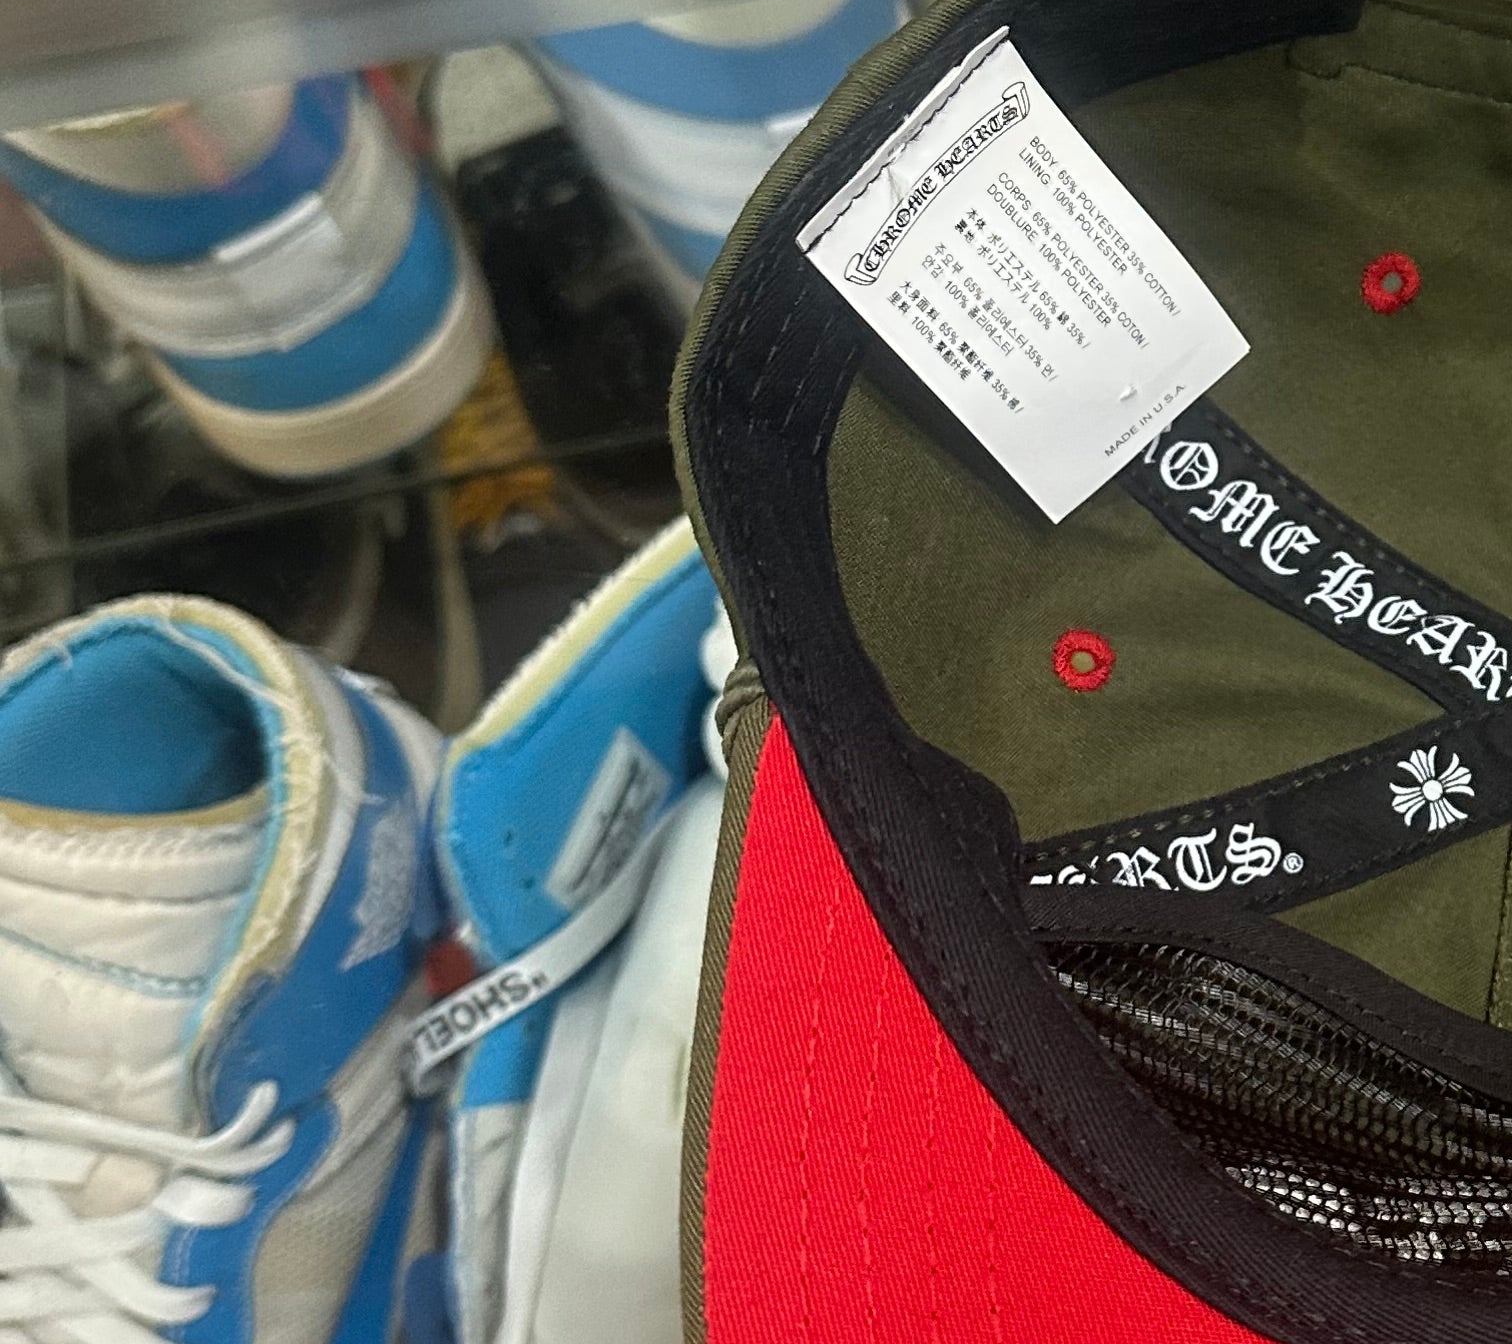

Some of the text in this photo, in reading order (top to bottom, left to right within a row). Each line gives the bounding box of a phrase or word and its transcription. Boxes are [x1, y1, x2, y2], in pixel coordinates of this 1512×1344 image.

[864, 104, 1022, 272] CHROME HEARTS
[1053, 187, 1076, 216] 100%
[1074, 213, 1128, 275] POLYESTER
[1057, 169, 1077, 194] 65%
[1076, 191, 1130, 254] POLYESTER
[1127, 251, 1146, 275] 35%
[944, 281, 969, 309] 100%
[977, 244, 1030, 304] ポリエステル
[1029, 304, 1052, 331] 100%
[987, 233, 1040, 293] ポリエステル
[1039, 290, 1059, 315] 65%
[1032, 211, 1052, 236] 65%
[1050, 233, 1104, 295] POLYESTER
[1101, 291, 1119, 314] 35%
[1039, 243, 1062, 271] 100%
[1061, 268, 1112, 328] POLYESTER
[911, 316, 936, 344] 100%
[938, 322, 959, 345] 65%
[991, 379, 1010, 401] 35%
[963, 277, 984, 301] 65%
[1024, 345, 1043, 368] 35%
[1104, 425, 1138, 457] MADE
[1139, 412, 1153, 426] IN
